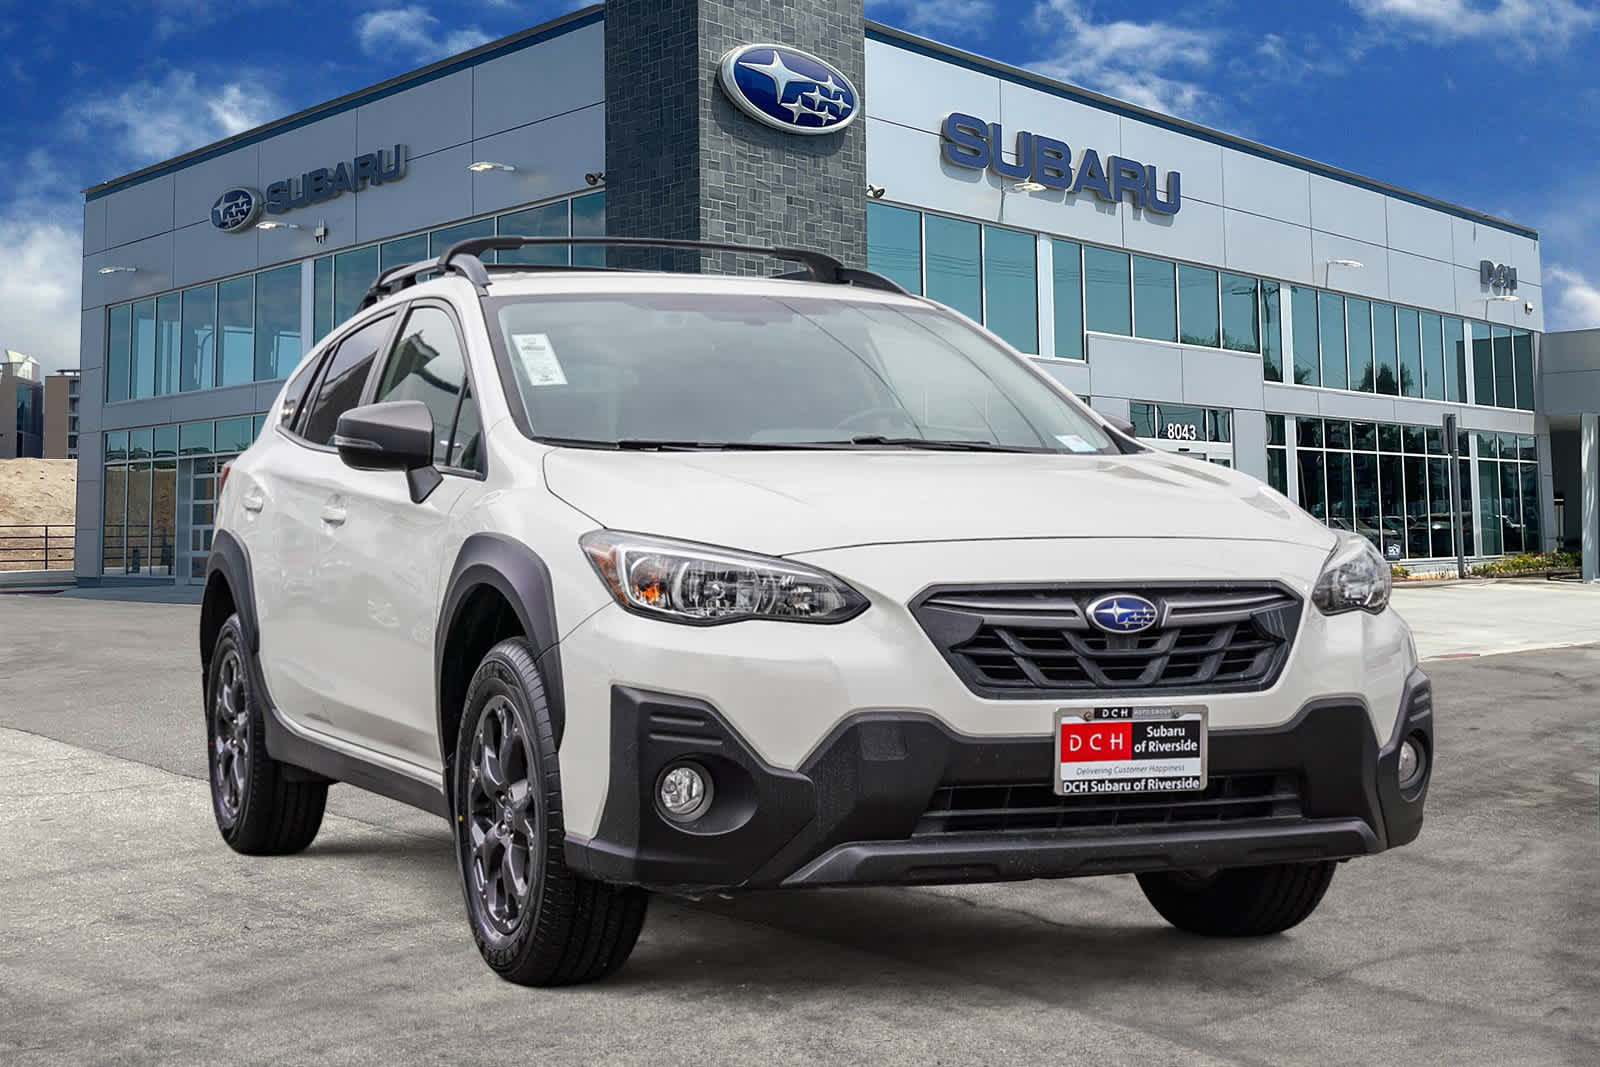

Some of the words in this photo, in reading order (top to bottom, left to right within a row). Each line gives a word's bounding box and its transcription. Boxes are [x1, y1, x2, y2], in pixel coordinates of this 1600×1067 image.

[941, 112, 1181, 215] SUBARU
[266, 144, 407, 214] SUBARU
[1167, 423, 1197, 440] 8043
[1102, 708, 1128, 718] DCH
[1146, 725, 1186, 738] Subaru
[1069, 732, 1124, 752] DCH
[1134, 740, 1146, 753] of
[1148, 738, 1198, 752] Riverside
[1076, 766, 1112, 776] Delivering
[1114, 765, 1148, 775] Customer
[1149, 764, 1185, 774] Happiness
[1063, 781, 1088, 793] DCH
[1090, 780, 1131, 792] Subaru
[1133, 779, 1146, 790] of
[1147, 777, 1200, 790] Riverside
